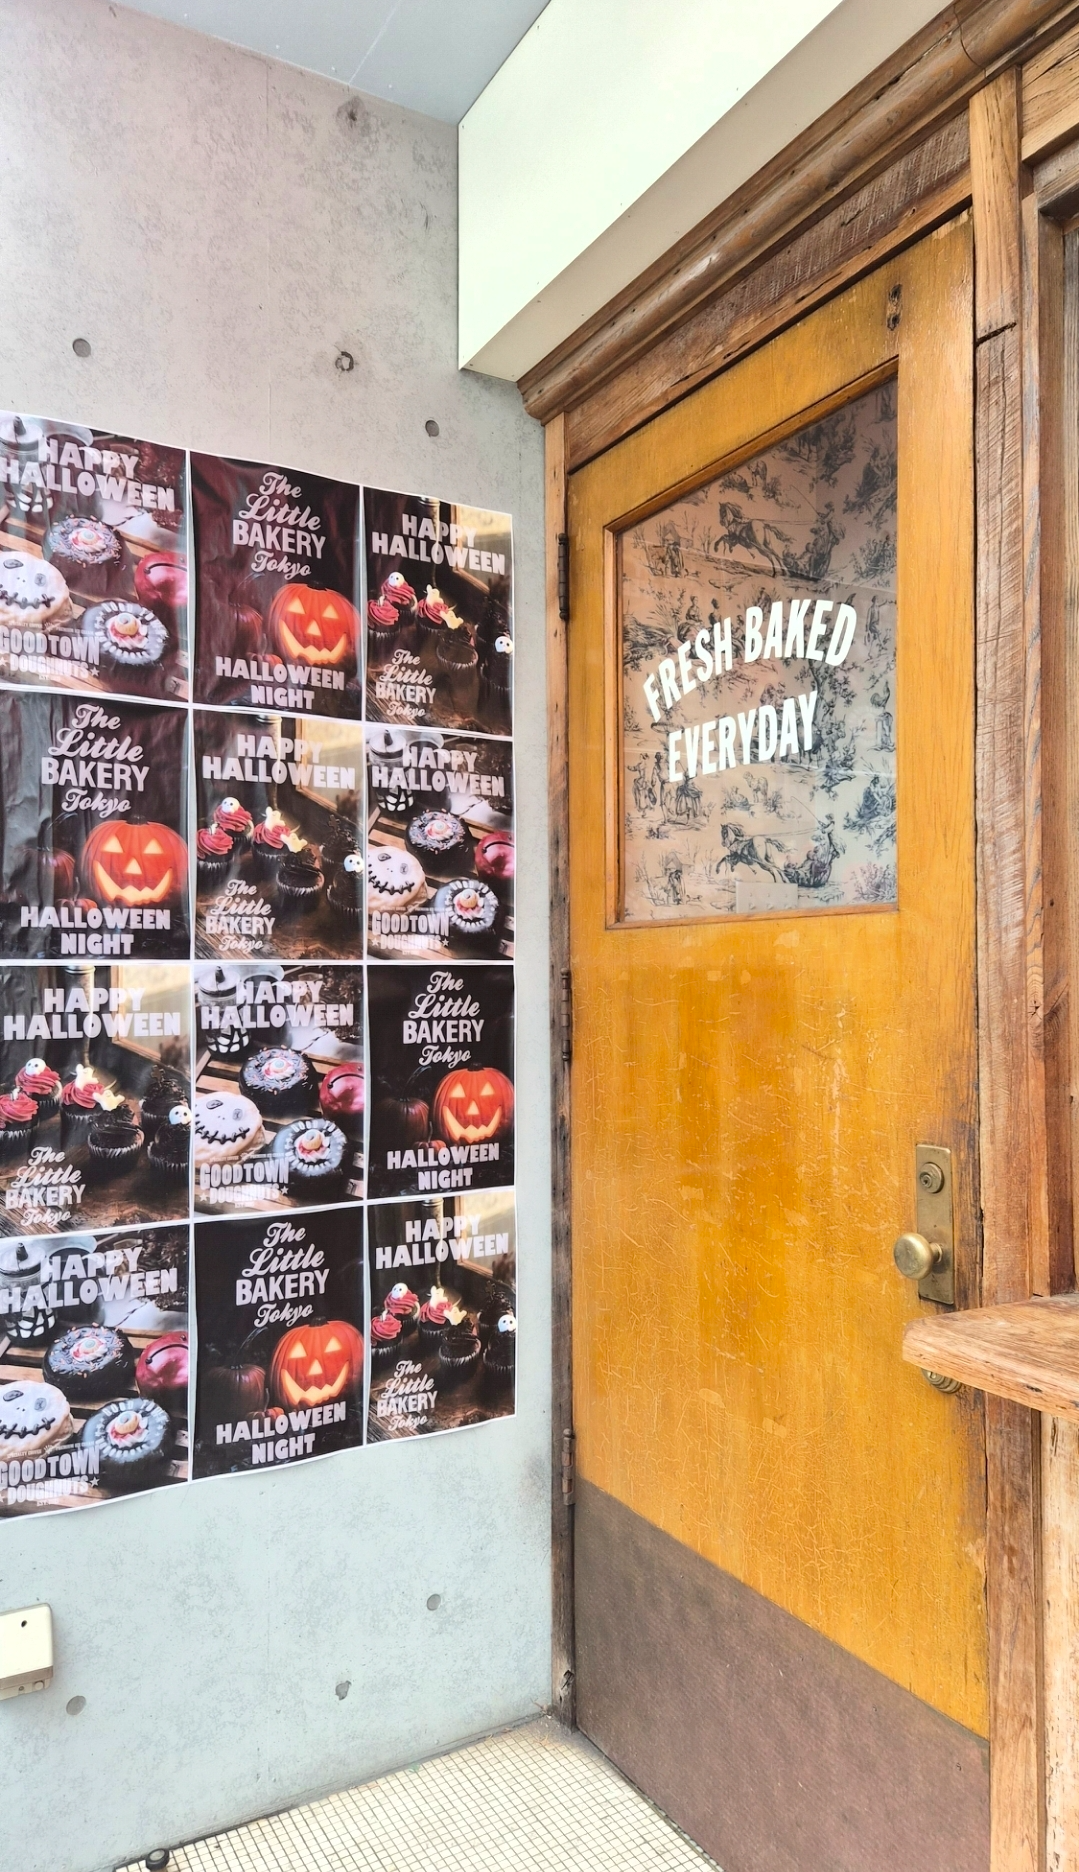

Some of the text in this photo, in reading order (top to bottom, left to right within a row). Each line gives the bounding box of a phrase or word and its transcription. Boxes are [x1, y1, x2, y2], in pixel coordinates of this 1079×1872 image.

[39, 439, 139, 479] HAPPY
[0, 457, 175, 512] HALLOWEEN
[258, 471, 303, 498] The
[239, 493, 322, 532] Little
[232, 518, 326, 559] BAKERY
[402, 513, 477, 548] HAPPY
[251, 549, 311, 580] Tokyo
[372, 531, 505, 576] HALLOWEEN
[391, 648, 421, 666] The
[643, 599, 857, 723] FRESH BAKED
[215, 656, 345, 691] HALLOWEEN
[379, 663, 434, 685] Little
[251, 685, 315, 710] NIGHT
[375, 682, 437, 704] BAKERY
[71, 703, 121, 730] The
[386, 701, 426, 720] Tokyo
[47, 727, 144, 763] Little
[237, 734, 324, 764] HAPPY
[669, 690, 818, 783] EVERYDAY
[202, 756, 356, 790] HALLOWEEN
[402, 746, 478, 773] HAPPY
[41, 757, 150, 793] BAKERY
[371, 766, 505, 798] HALLOWEEN
[61, 788, 132, 819] Tokyo
[224, 879, 257, 898] The
[20, 906, 171, 930] HALLOWEEN
[210, 894, 272, 916] Little
[205, 916, 276, 936] BAKERY
[60, 933, 134, 955] NIGHT
[218, 935, 264, 953] Tokyo
[236, 980, 324, 1004] HAPPY
[427, 971, 464, 993] The
[44, 987, 146, 1013] HAPPY
[408, 994, 480, 1019] Little
[4, 1012, 181, 1040] HALLOWEEN
[201, 1004, 354, 1029] HALLOWEEN
[403, 1019, 484, 1045] BAKERY
[418, 1044, 472, 1068] Tokyo
[28, 1146, 66, 1165] The
[387, 1142, 500, 1170] HALLOWEEN
[11, 1164, 82, 1188] Little
[418, 1167, 473, 1191] NIGHT
[5, 1183, 86, 1210] BAKERY
[21, 1208, 72, 1228] Tokyo
[405, 1214, 482, 1244] HAPPY
[263, 1222, 306, 1248] The
[40, 1246, 142, 1283] HAPPY
[241, 1244, 325, 1278] Little
[375, 1232, 509, 1270] HALLOWEEN
[0, 1268, 178, 1314] HALLOWEEN
[235, 1268, 330, 1306] BAKERY
[253, 1301, 314, 1328] Tokyo
[394, 1359, 422, 1378] The
[380, 1374, 434, 1399] Little
[377, 1391, 438, 1418] BAKERY
[216, 1401, 346, 1445] HALLOWEEN
[388, 1415, 428, 1431] Tokyo
[251, 1433, 316, 1464] NIGHT
